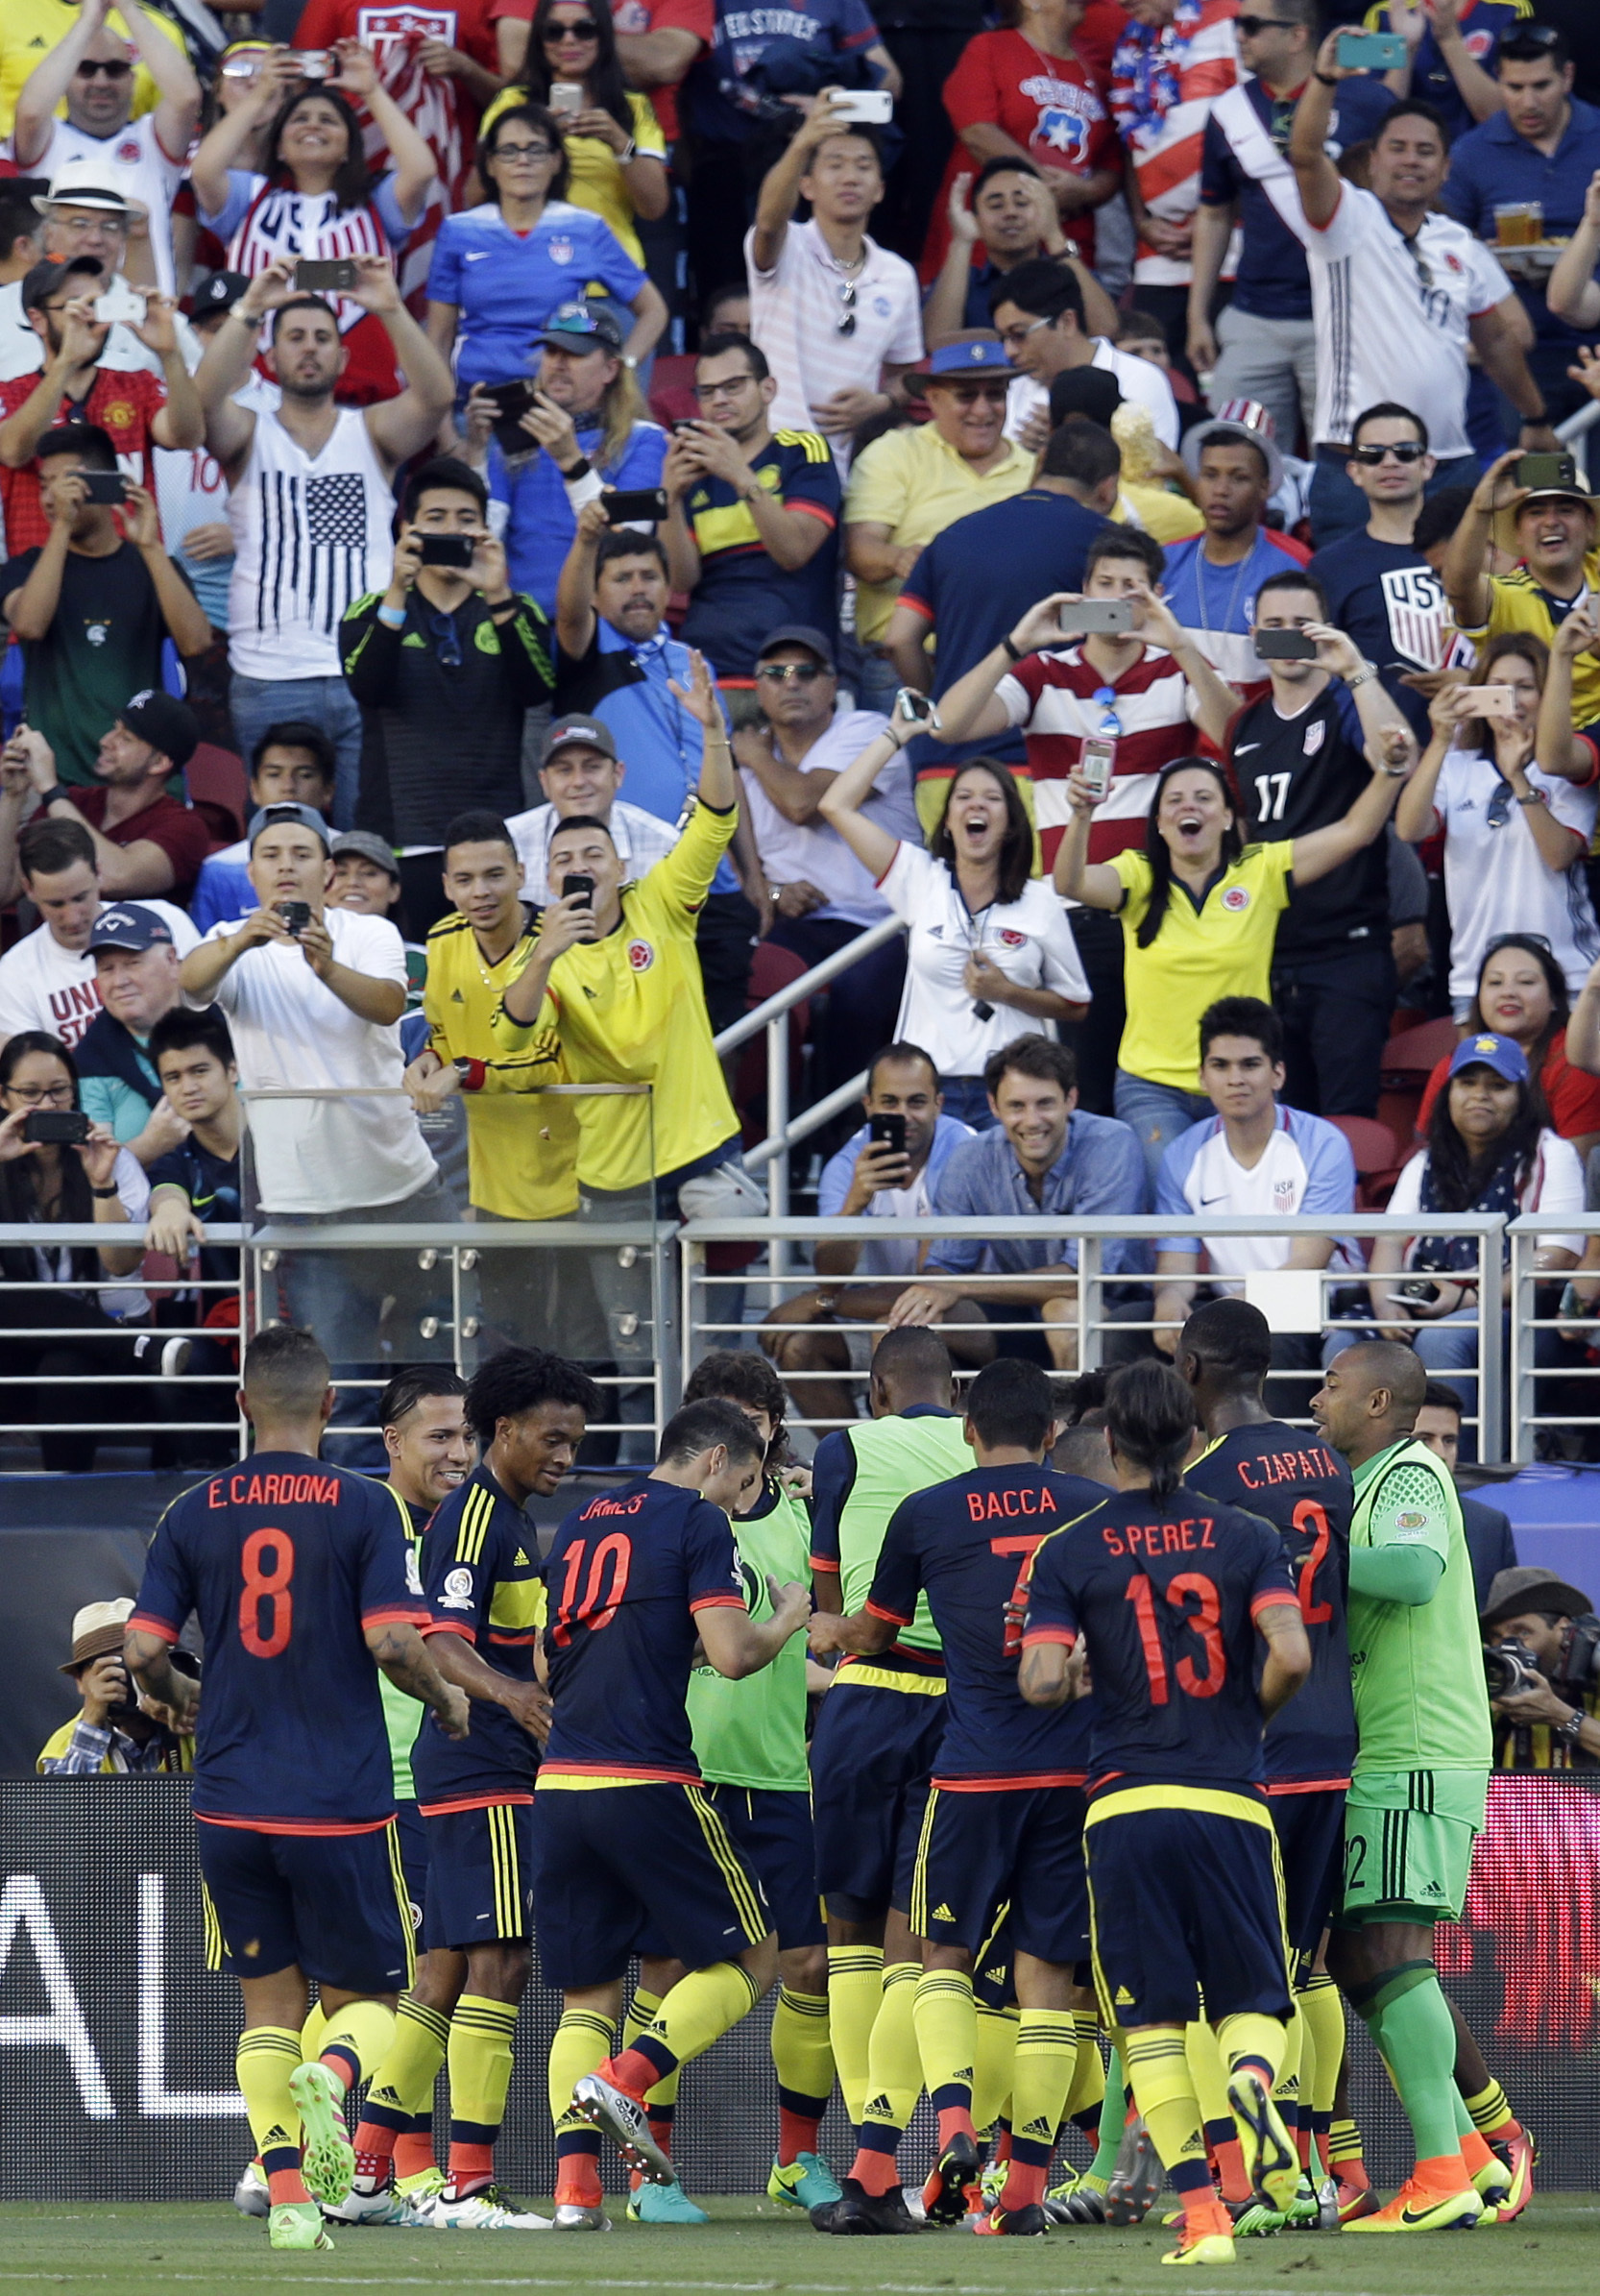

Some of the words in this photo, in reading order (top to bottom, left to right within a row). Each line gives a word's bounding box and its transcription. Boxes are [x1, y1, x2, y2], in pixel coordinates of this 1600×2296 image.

[1390, 574, 1443, 609] US
[1254, 771, 1292, 823] 17
[1274, 1181, 1294, 1194] USA
[1238, 1448, 1340, 1490] C.ZAPATA
[208, 1474, 340, 1509] E.CARDONA
[967, 1486, 1056, 1522] BACCA
[1103, 1518, 1216, 1556] S.PEREZ
[1291, 1499, 1333, 1625] 2
[238, 1527, 295, 1659] 8
[552, 1532, 632, 1649] 10
[1125, 1572, 1227, 1706] 13
[370, 2089, 402, 2107] adidas
[864, 2105, 894, 2119] adidas
[614, 2098, 638, 2137] adidas
[260, 2136, 291, 2148] adidas
